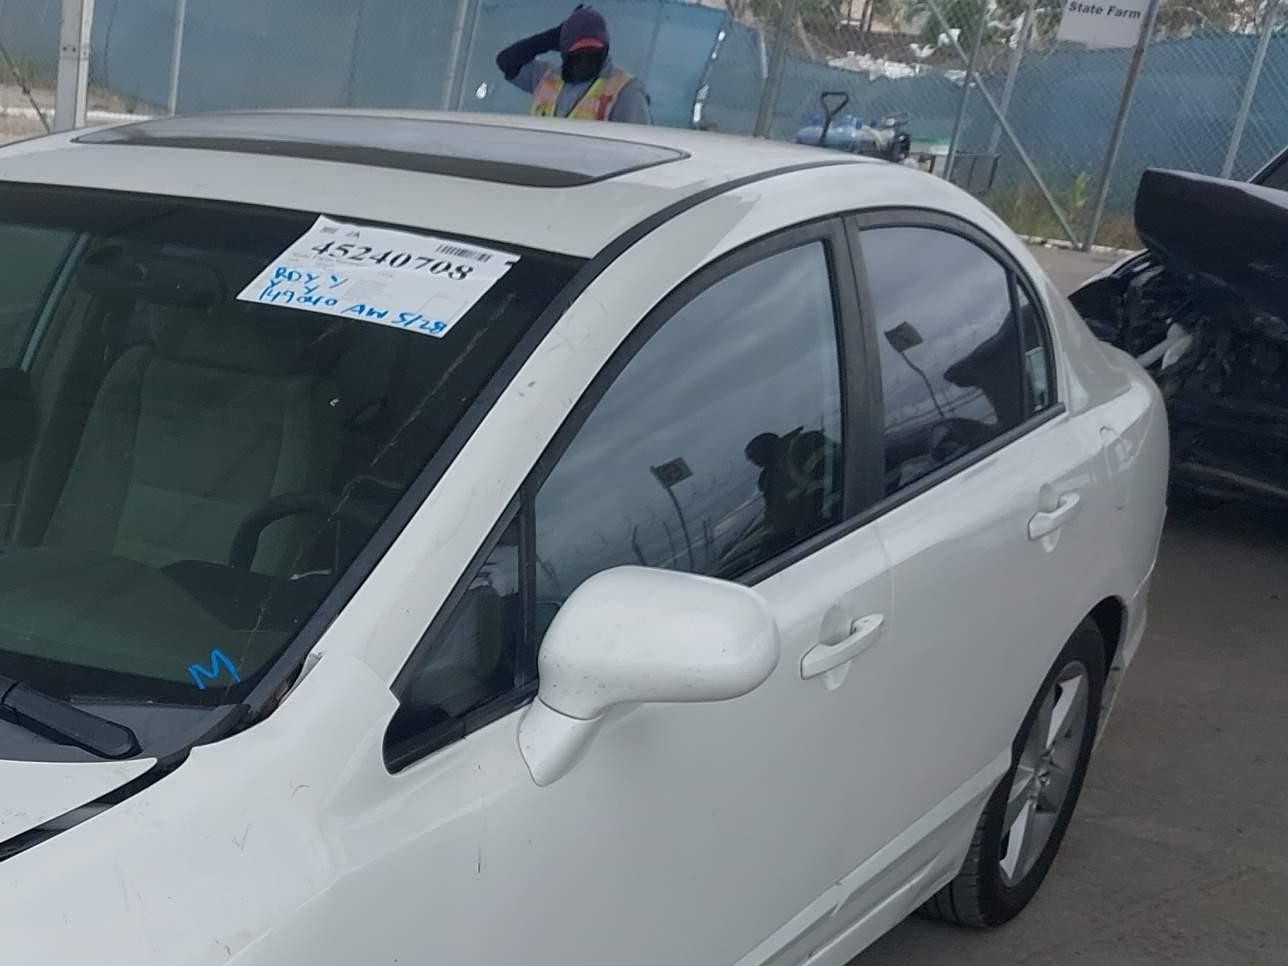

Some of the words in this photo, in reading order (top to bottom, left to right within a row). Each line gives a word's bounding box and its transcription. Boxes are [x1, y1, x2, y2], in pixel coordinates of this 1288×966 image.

[1068, 1, 1104, 15] State
[1106, 5, 1142, 20] Farm
[312, 241, 474, 281] 45240708
[391, 312, 447, 334] 5/28
[187, 649, 241, 690] M
